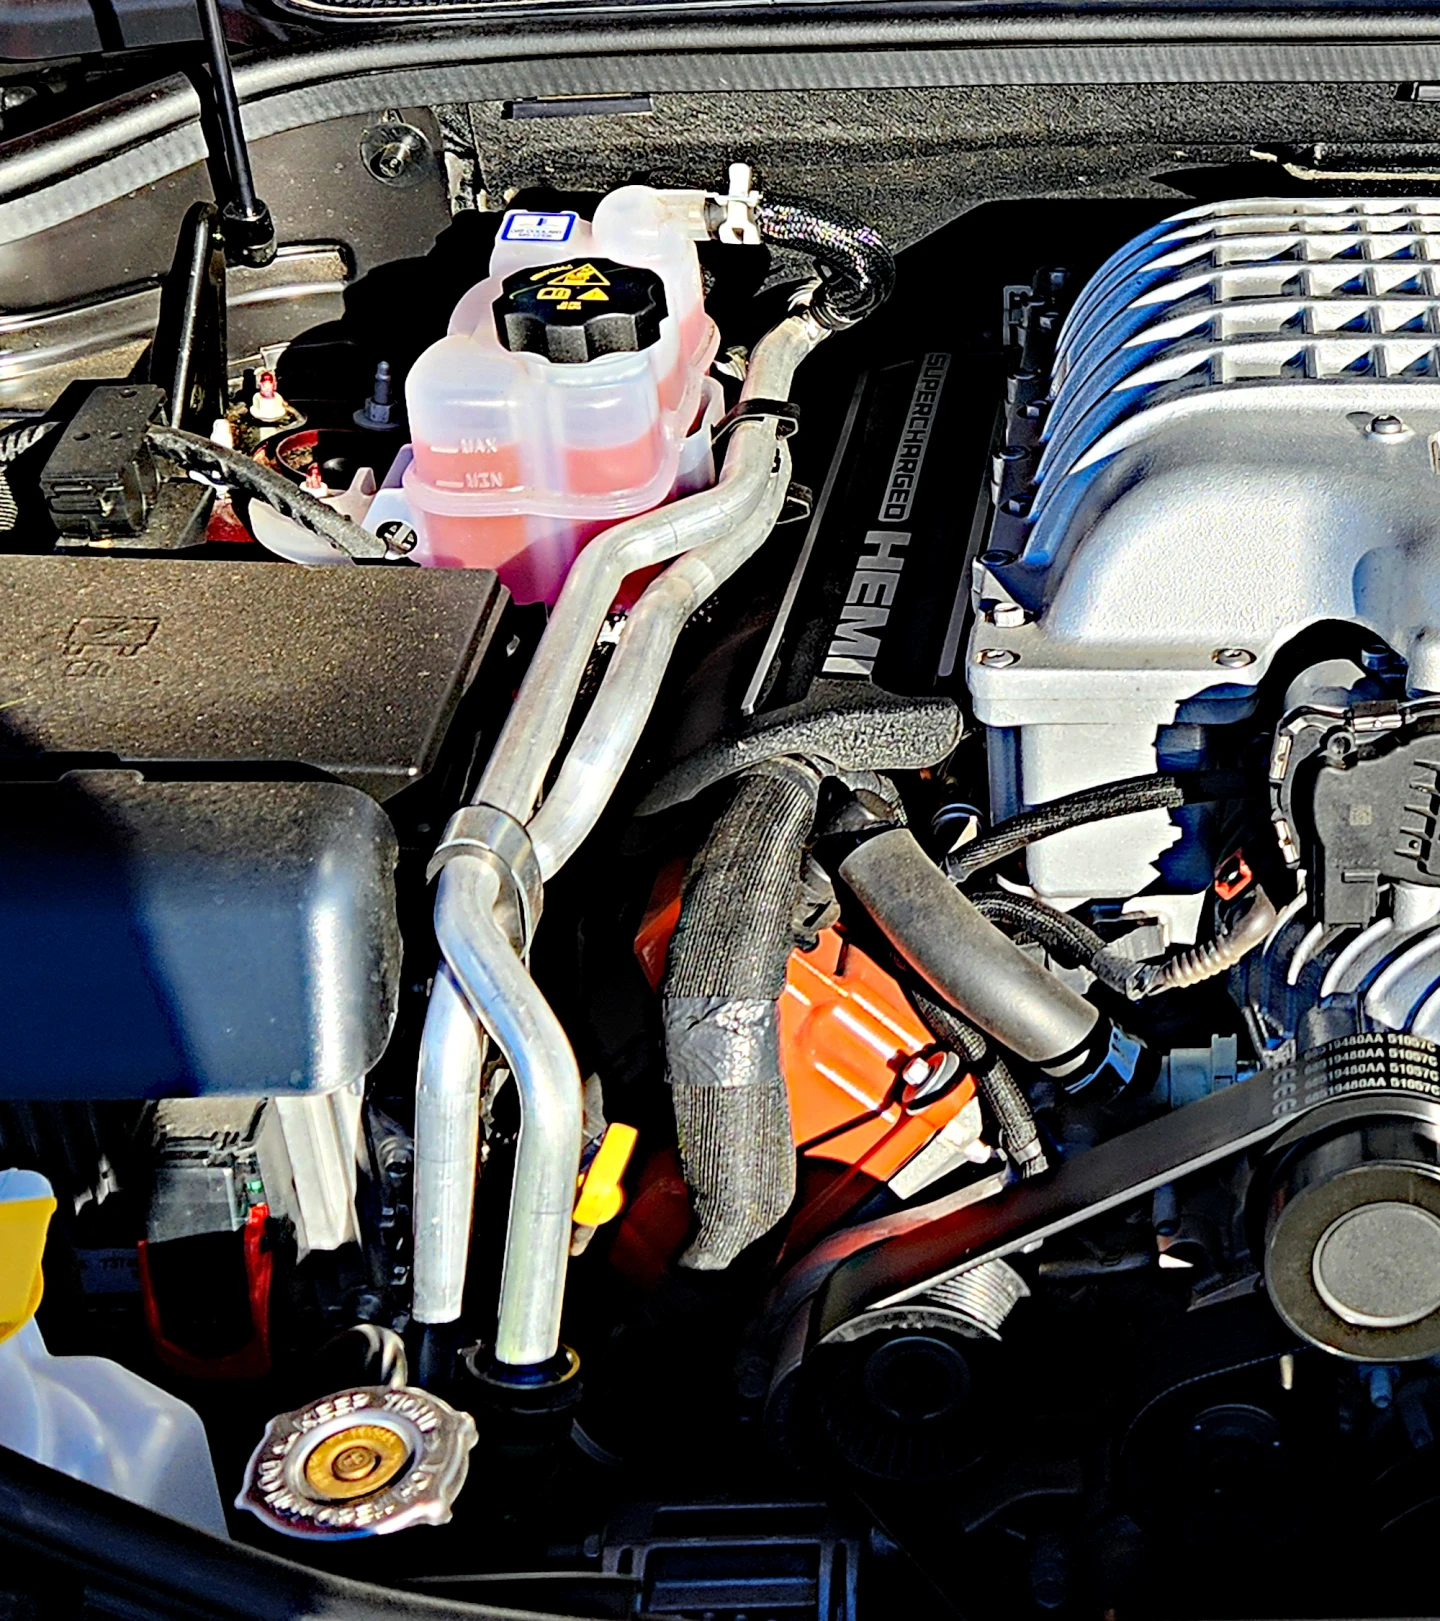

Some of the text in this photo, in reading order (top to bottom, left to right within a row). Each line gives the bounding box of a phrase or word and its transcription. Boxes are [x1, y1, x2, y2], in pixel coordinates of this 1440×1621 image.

[459, 436, 498, 455] MAX
[464, 471, 504, 489] MIN
[822, 353, 948, 676] SUPERCHARGED HEMI
[292, 1391, 372, 1433] KEEP
